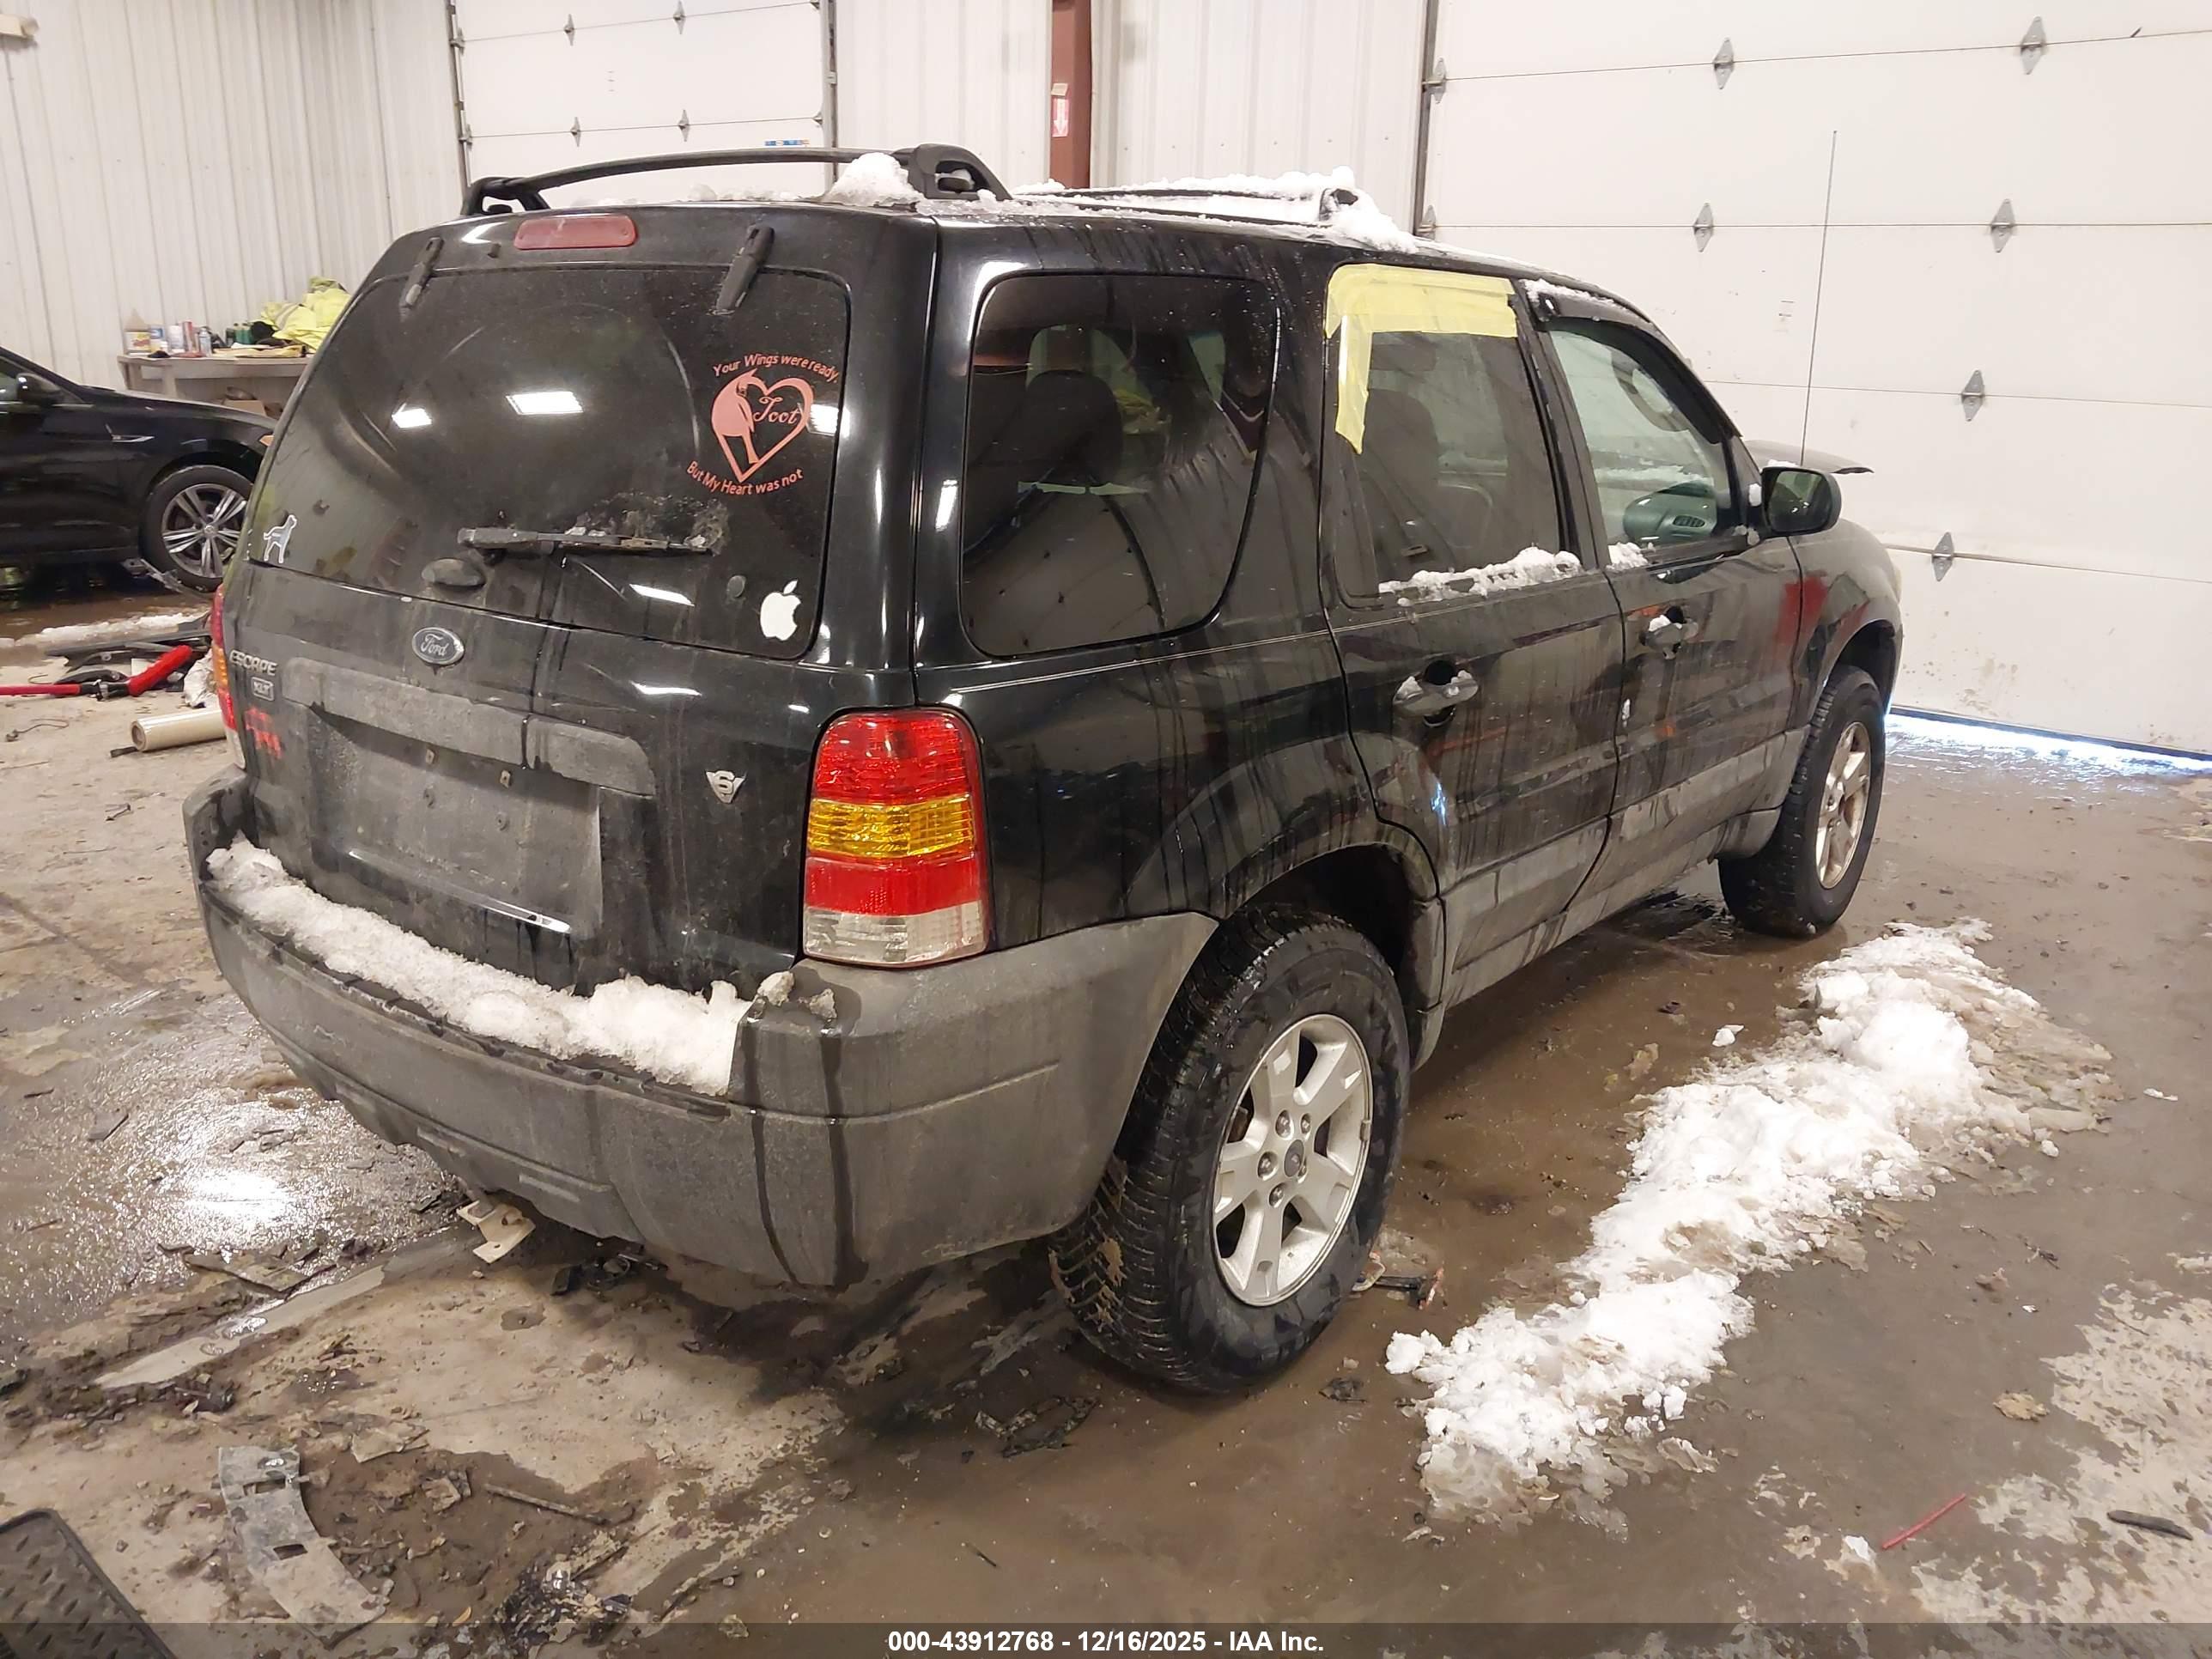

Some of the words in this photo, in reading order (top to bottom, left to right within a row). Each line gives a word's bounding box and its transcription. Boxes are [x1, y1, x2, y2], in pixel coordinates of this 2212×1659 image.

[713, 361, 741, 377] Your
[744, 353, 780, 368] Wings
[781, 356, 809, 368] were
[687, 460, 704, 482] But
[702, 471, 721, 493] My
[720, 479, 753, 495] Heart
[756, 480, 781, 494] was
[781, 469, 804, 487] not
[421, 633, 450, 656] Ford
[229, 649, 277, 676] ESCAPE
